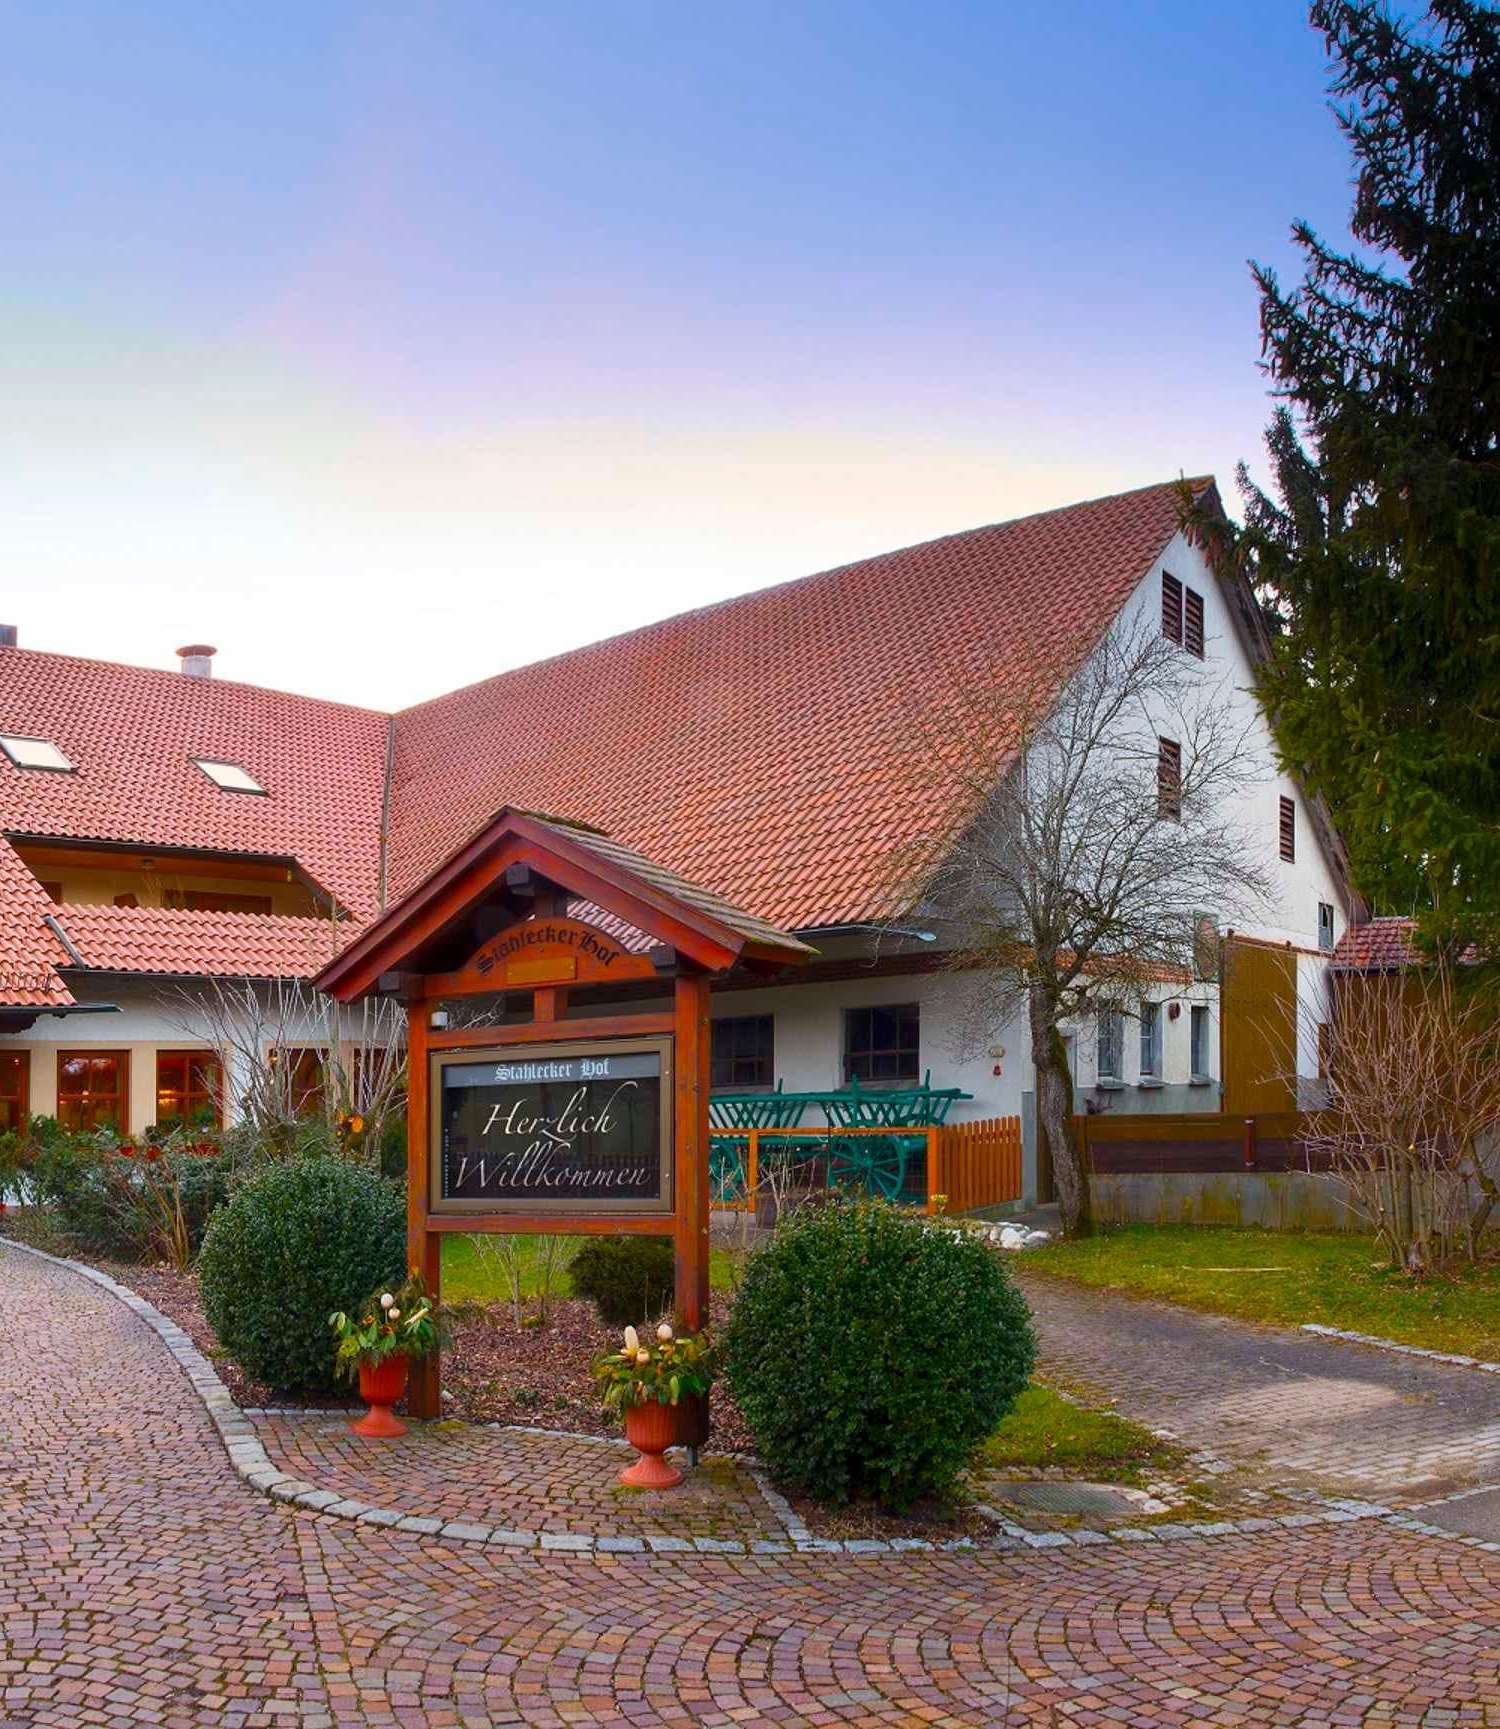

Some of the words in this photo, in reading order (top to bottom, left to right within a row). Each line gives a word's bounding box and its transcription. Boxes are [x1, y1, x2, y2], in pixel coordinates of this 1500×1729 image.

[494, 1062, 573, 1081] Stahlecker
[579, 1058, 611, 1079] Hof
[481, 1080, 638, 1143] Herzlich
[454, 1141, 650, 1189] Willkommen
